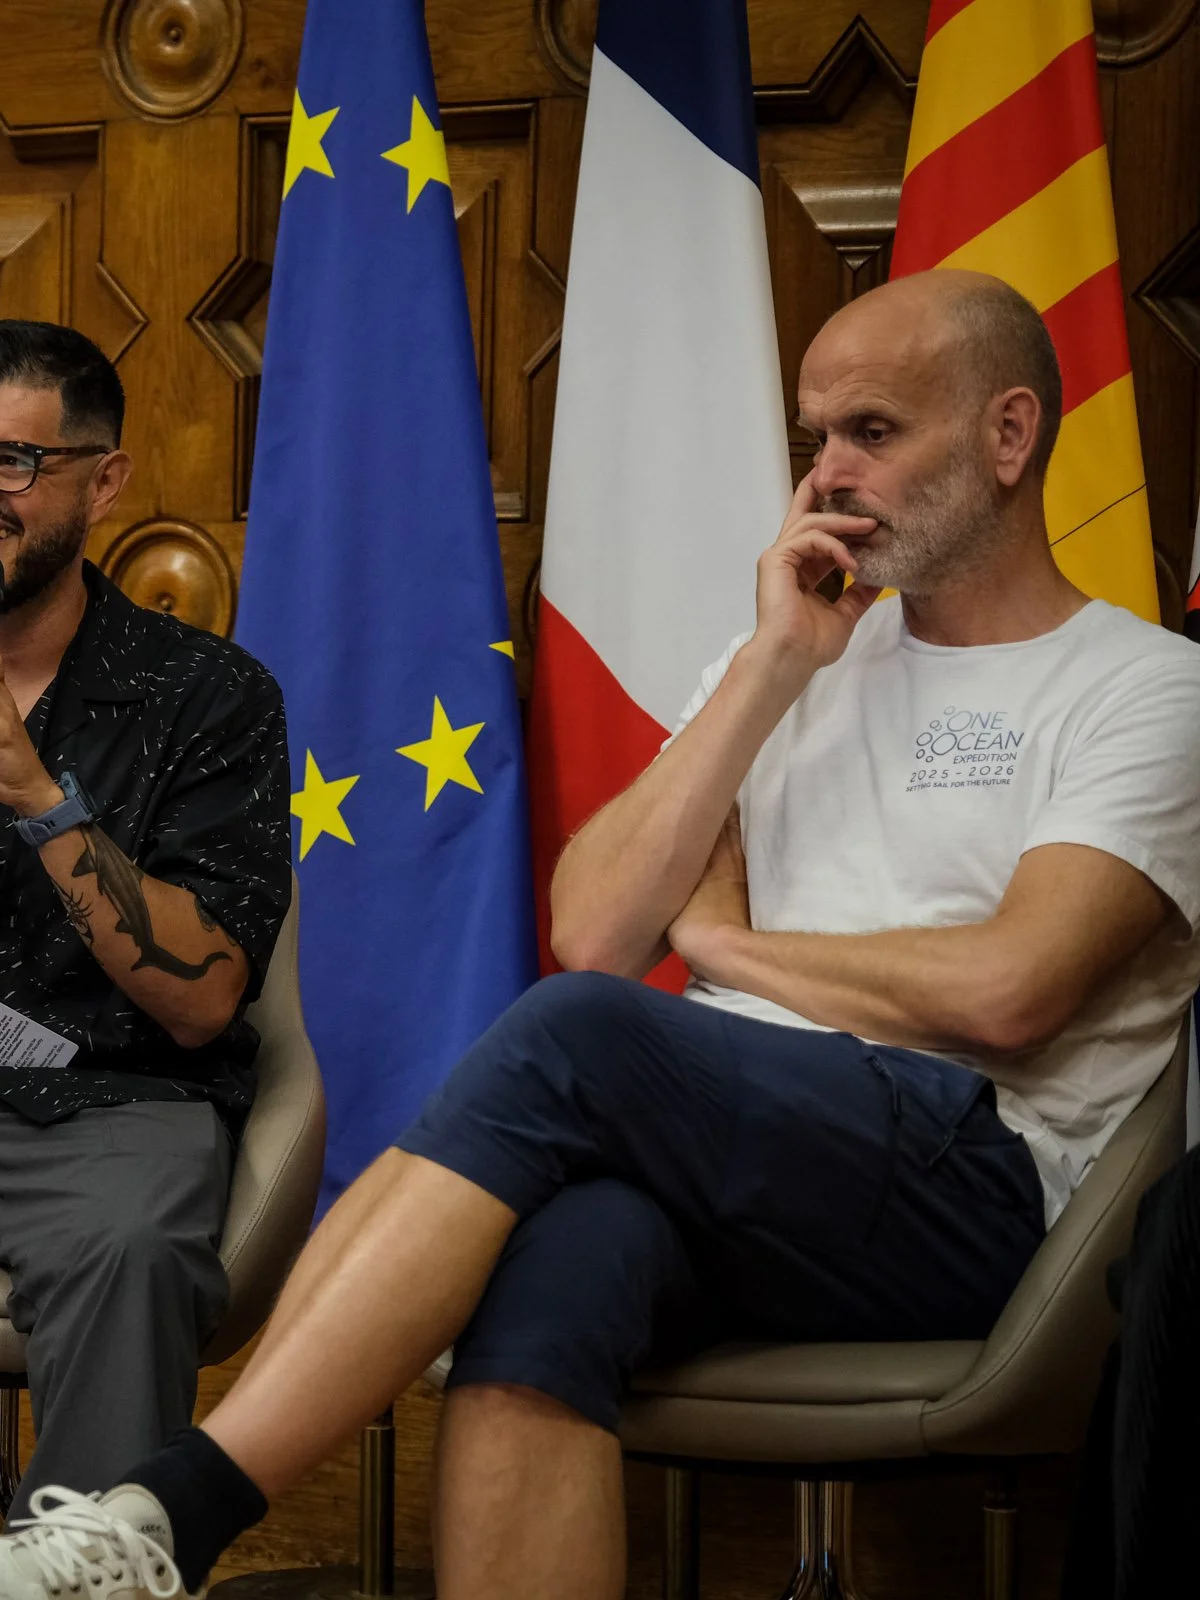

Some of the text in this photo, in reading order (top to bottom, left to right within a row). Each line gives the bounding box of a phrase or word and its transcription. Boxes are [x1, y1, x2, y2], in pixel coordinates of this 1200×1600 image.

[947, 710, 1008, 732] ONE
[930, 730, 1025, 756] OCEAN
[953, 752, 1018, 764] EXPEDITION
[982, 778, 1011, 786] FUTURE
